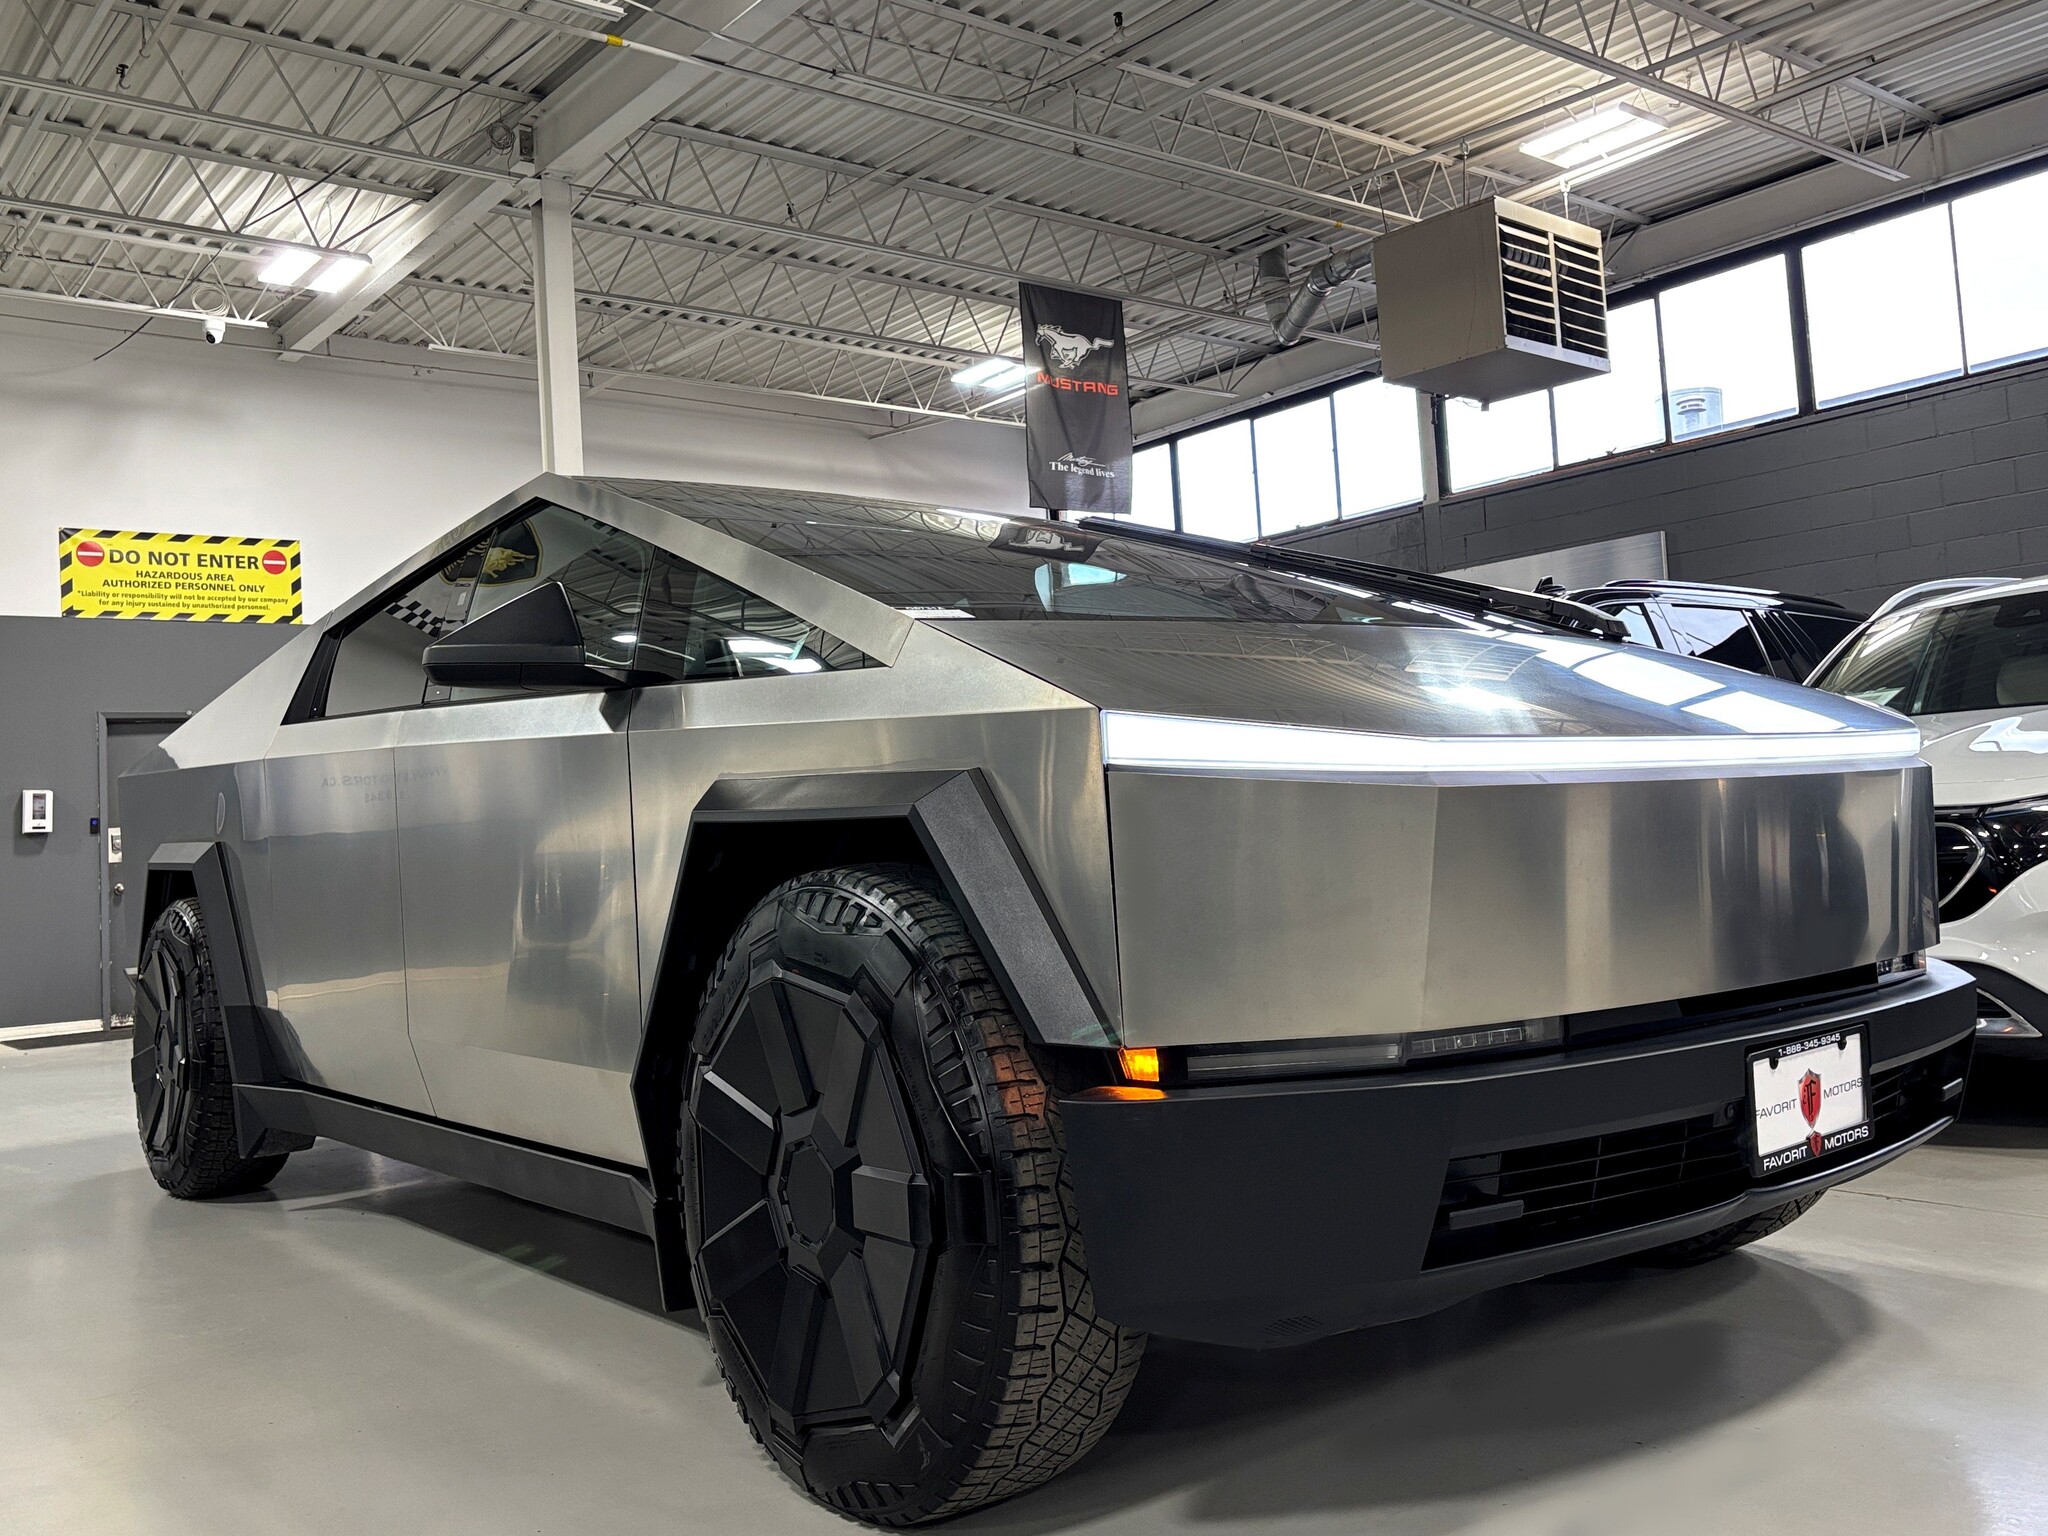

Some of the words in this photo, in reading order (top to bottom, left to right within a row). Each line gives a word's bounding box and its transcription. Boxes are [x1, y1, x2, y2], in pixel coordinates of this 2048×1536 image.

[1037, 371, 1119, 396] MUSTANG
[1048, 461, 1069, 472] The
[1070, 463, 1095, 476] legend
[1095, 468, 1115, 478] lives
[109, 549, 141, 565] DO
[148, 551, 190, 567] NOT
[197, 553, 259, 570] ENTER
[136, 570, 203, 581] HAZARDOUS
[206, 573, 235, 582] AREA
[102, 579, 172, 590] AUTHORIZED
[175, 582, 236, 592] PERSONNEL
[239, 584, 265, 593] ONLY
[121, 591, 168, 600] responsibility
[207, 595, 237, 603] accepted
[238, 596, 246, 604] by
[126, 600, 146, 608] injury
[192, 602, 236, 610] unauthorized
[1778, 1033, 1841, 1056] 1-888-345-9345
[1756, 1098, 1797, 1119] FAVORIT
[1823, 1077, 1864, 1099] MOTORS
[1763, 1145, 1808, 1171] FAVORIT
[1824, 1126, 1869, 1150] MOTORS
